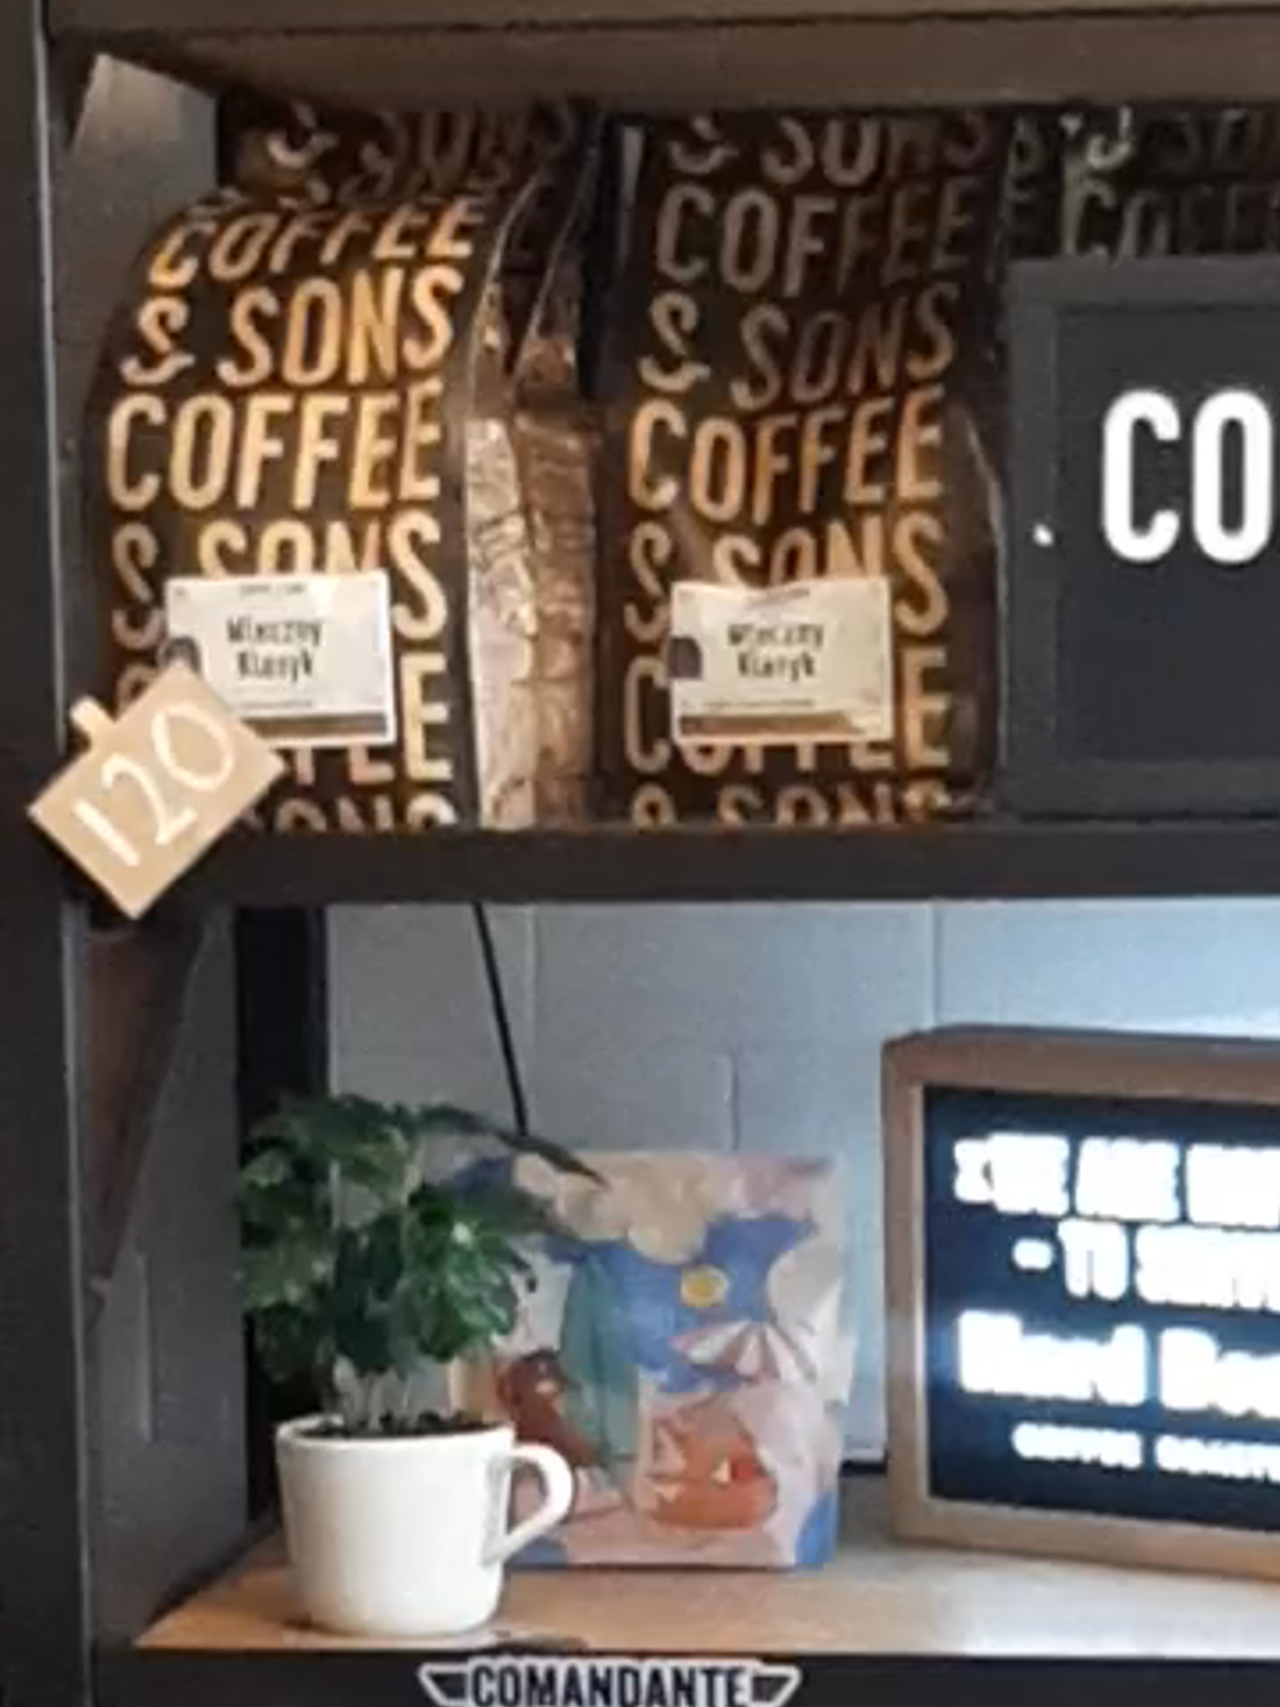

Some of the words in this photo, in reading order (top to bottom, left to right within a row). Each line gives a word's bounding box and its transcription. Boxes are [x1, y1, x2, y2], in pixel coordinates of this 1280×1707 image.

[148, 195, 488, 289] COFFEE
[656, 181, 978, 295] COFFEE
[215, 265, 464, 389] SONS
[730, 282, 958, 410] SONS
[106, 378, 444, 515] COFFEE
[626, 385, 946, 527] COFFEE
[71, 703, 239, 869] 120
